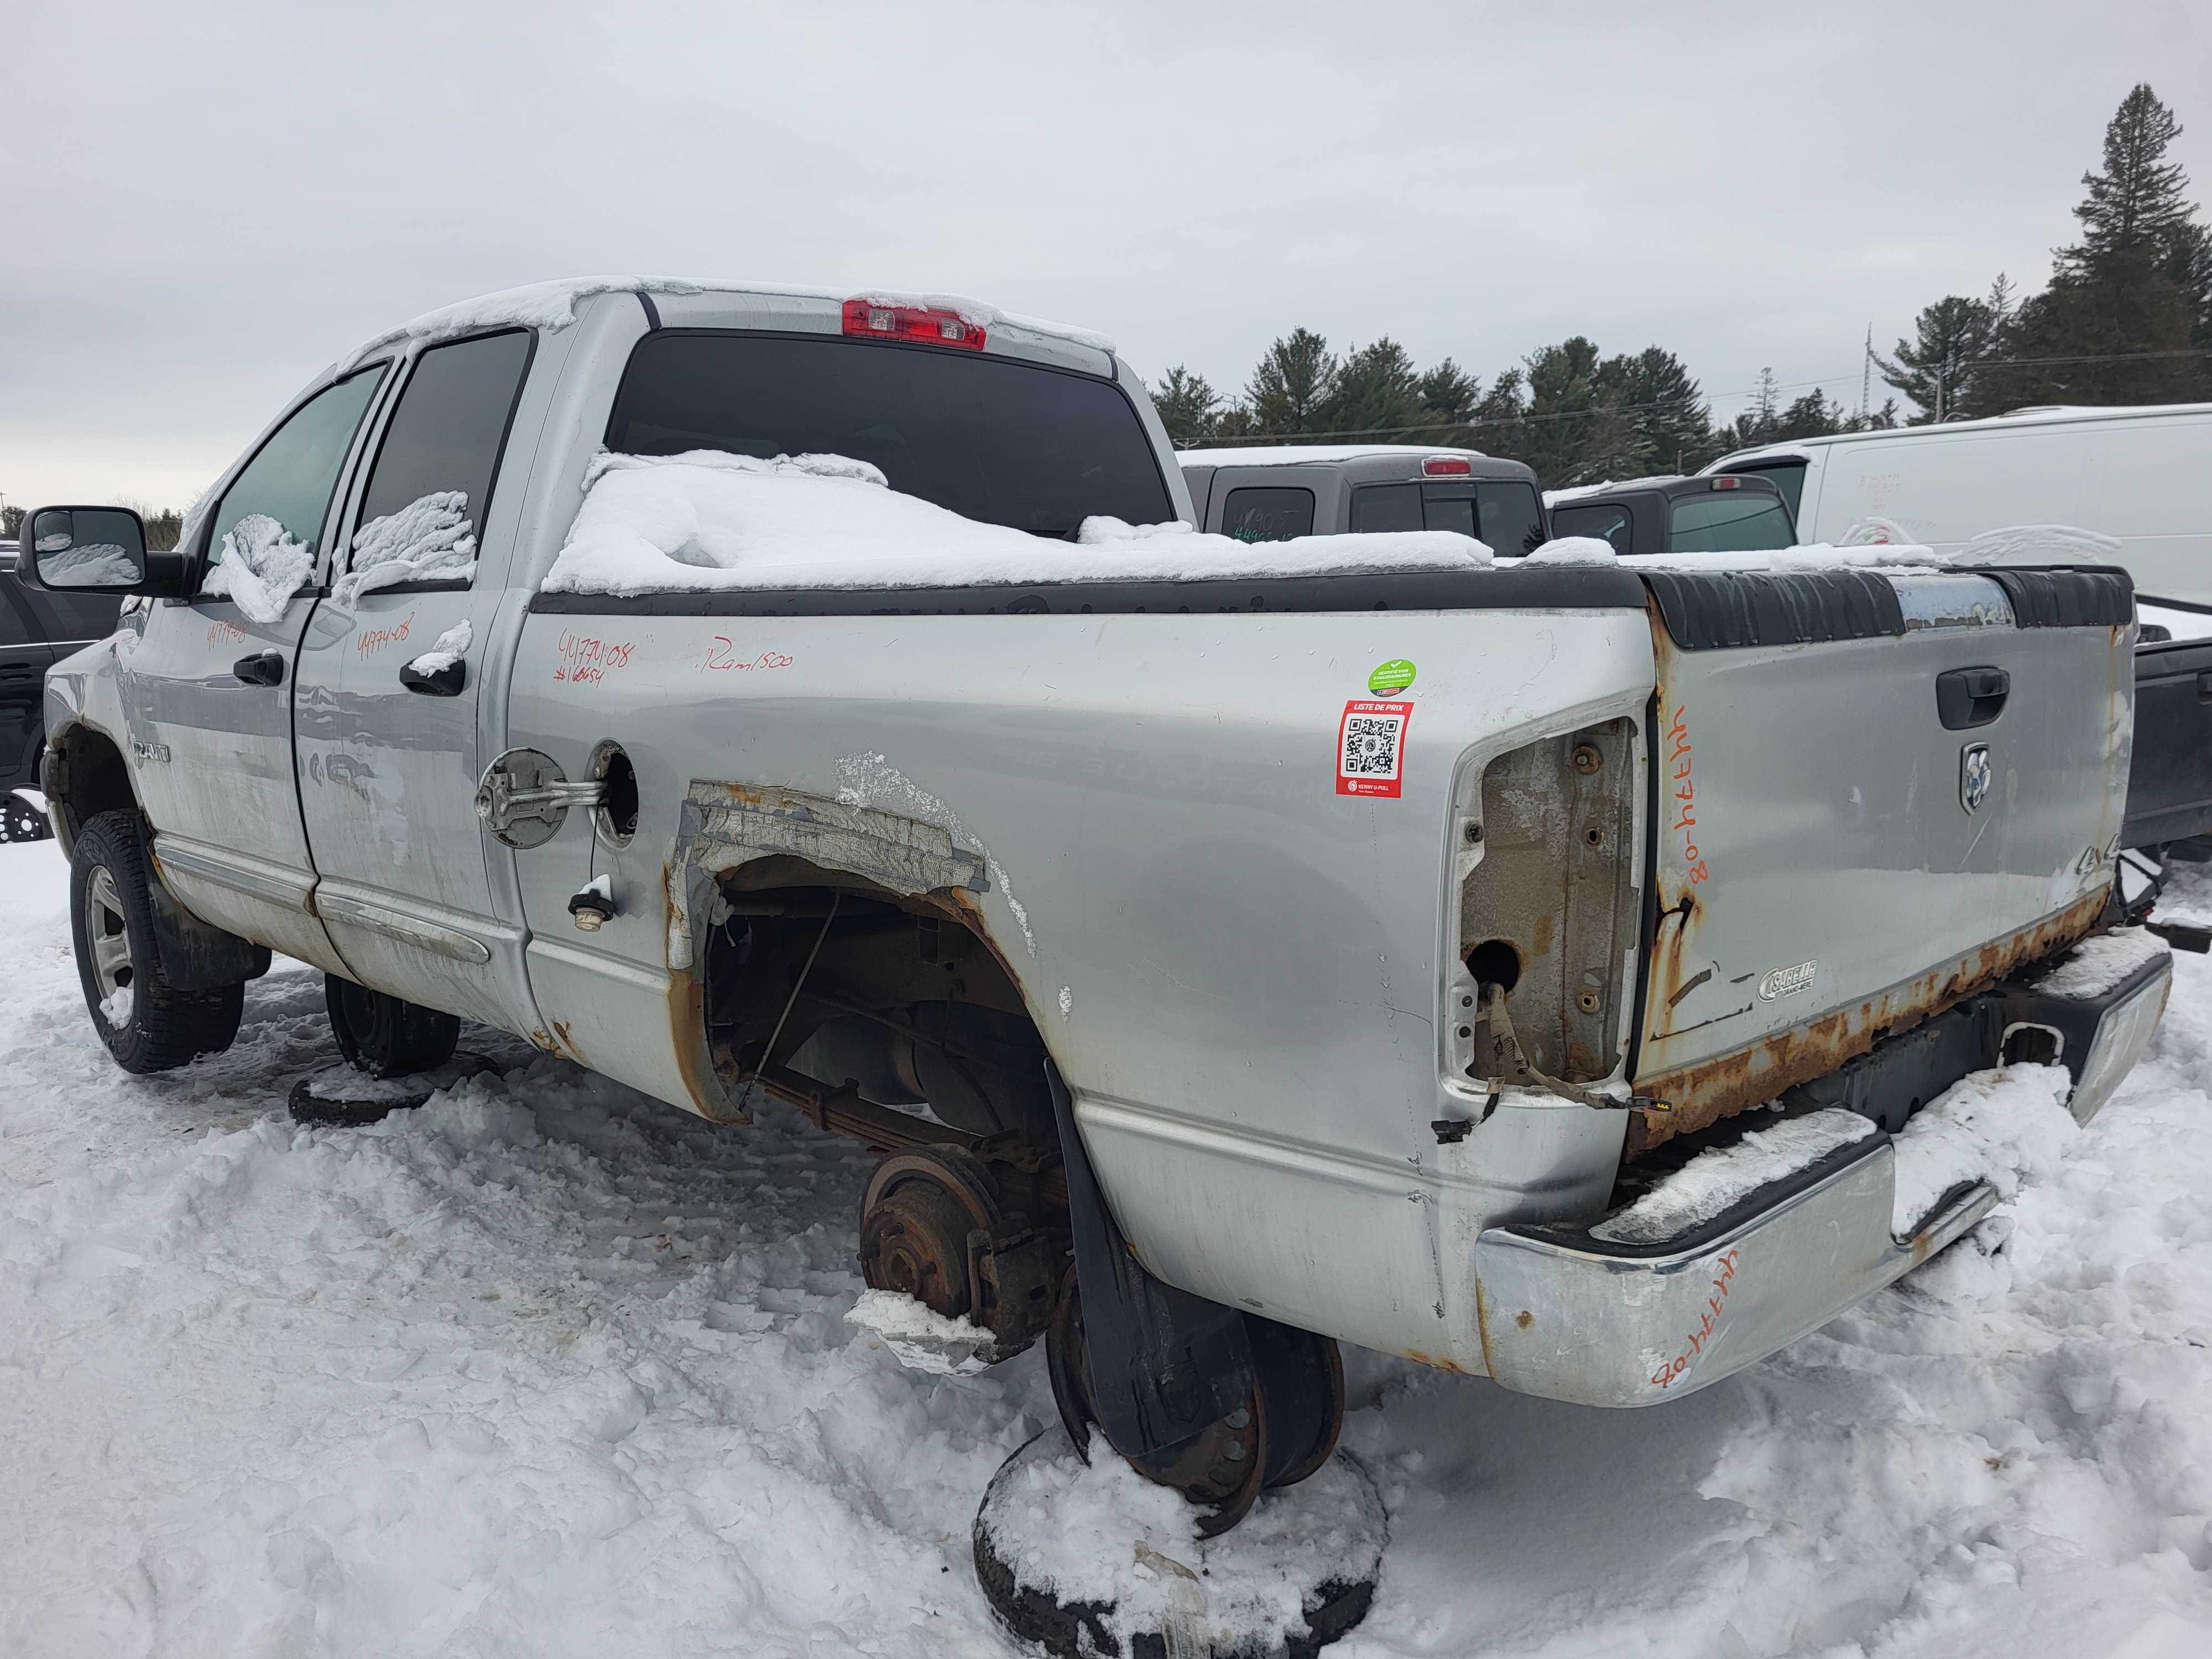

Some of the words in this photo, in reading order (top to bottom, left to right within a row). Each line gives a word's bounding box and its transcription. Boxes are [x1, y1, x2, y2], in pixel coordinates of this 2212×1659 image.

[207, 619, 250, 650] 44774-08
[358, 612, 415, 661] 44774-08
[133, 740, 171, 763] RAM
[1666, 705, 1708, 884] 44774-08
[1766, 961, 1816, 994] ISABELLE
[1651, 1250, 1738, 1389] 44774-08
